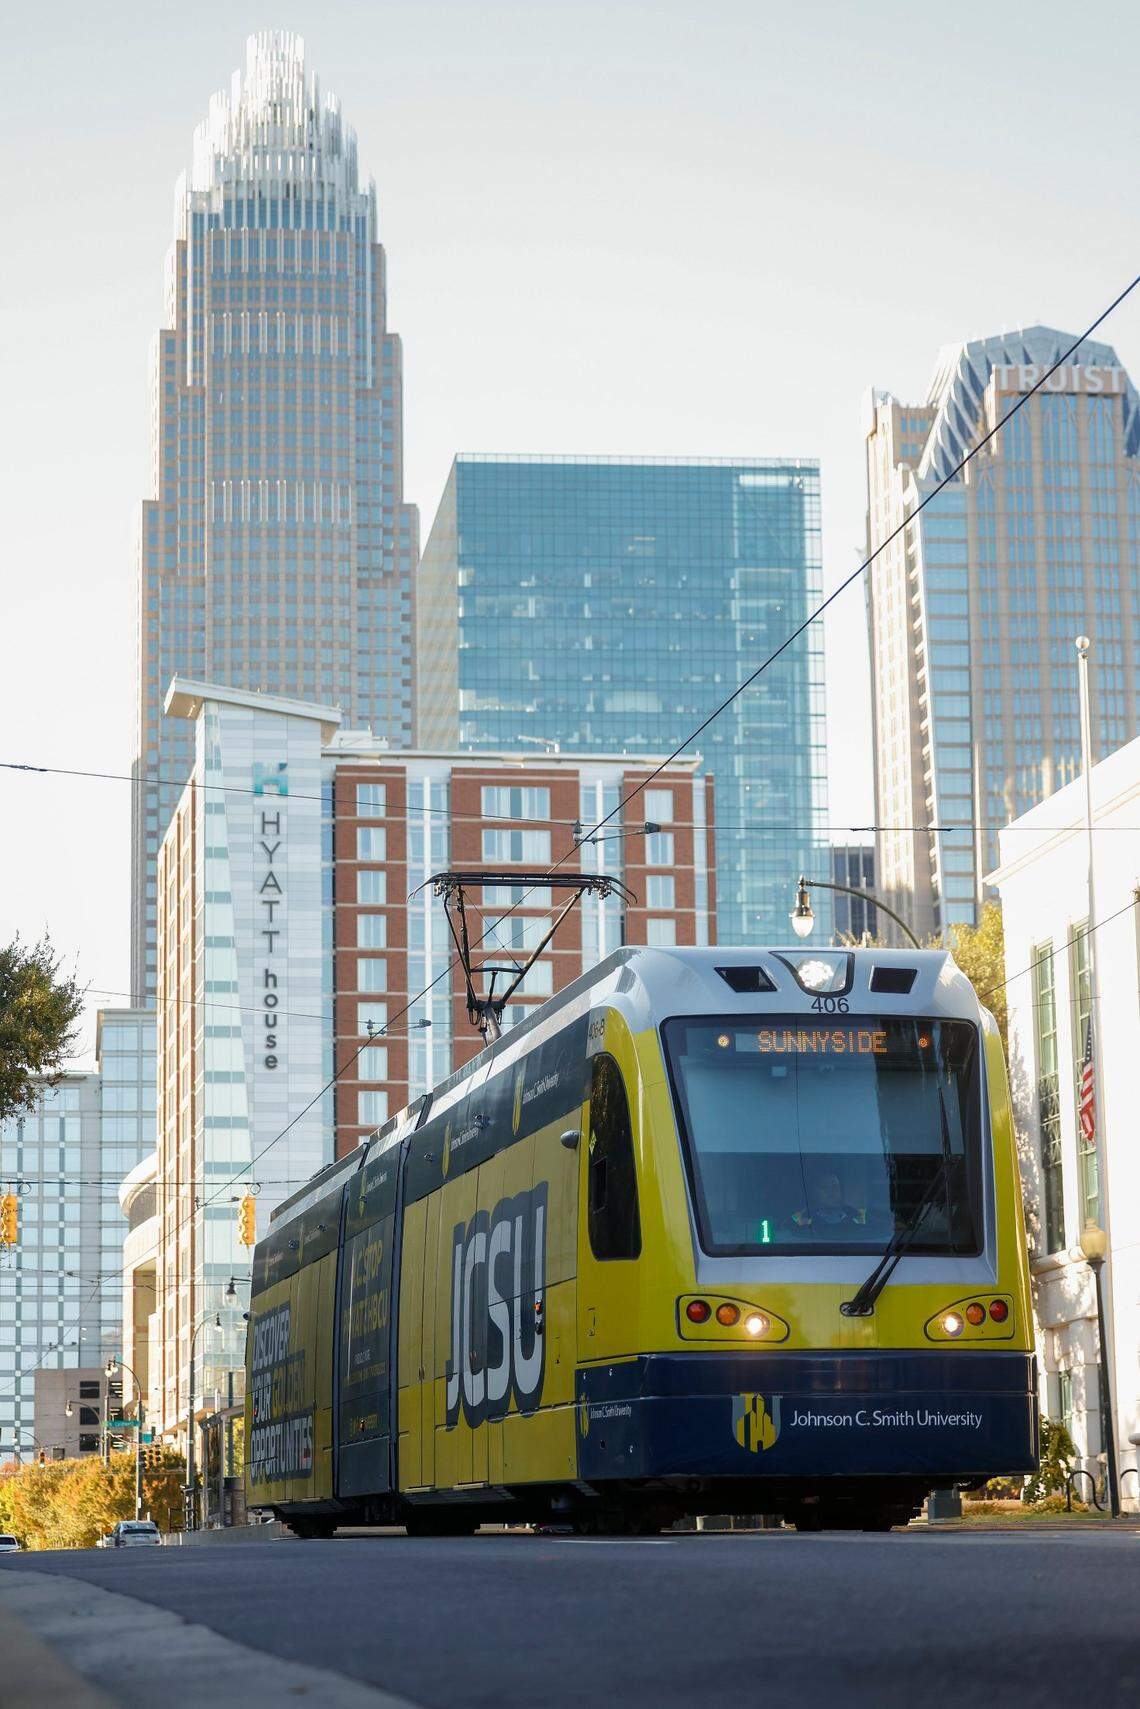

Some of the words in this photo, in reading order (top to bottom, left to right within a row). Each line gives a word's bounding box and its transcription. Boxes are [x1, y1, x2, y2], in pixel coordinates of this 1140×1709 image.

[999, 364, 1121, 392] TRUIST
[260, 811, 282, 953] HYATT
[264, 969, 278, 1069] house
[811, 997, 850, 1014] 406
[758, 1031, 887, 1053] SUNNYSIDE
[761, 1220, 770, 1243] 1
[368, 1289, 387, 1331] HBCU
[447, 1206, 544, 1410] JCSU
[253, 1309, 290, 1371] DISCOVER
[252, 1372, 272, 1424] YOUR
[790, 1410, 852, 1426] Johnson
[855, 1410, 870, 1426] C.
[873, 1410, 914, 1426] Smith
[917, 1410, 982, 1429] University
[251, 1415, 312, 1478] OPPORTUNITIES
